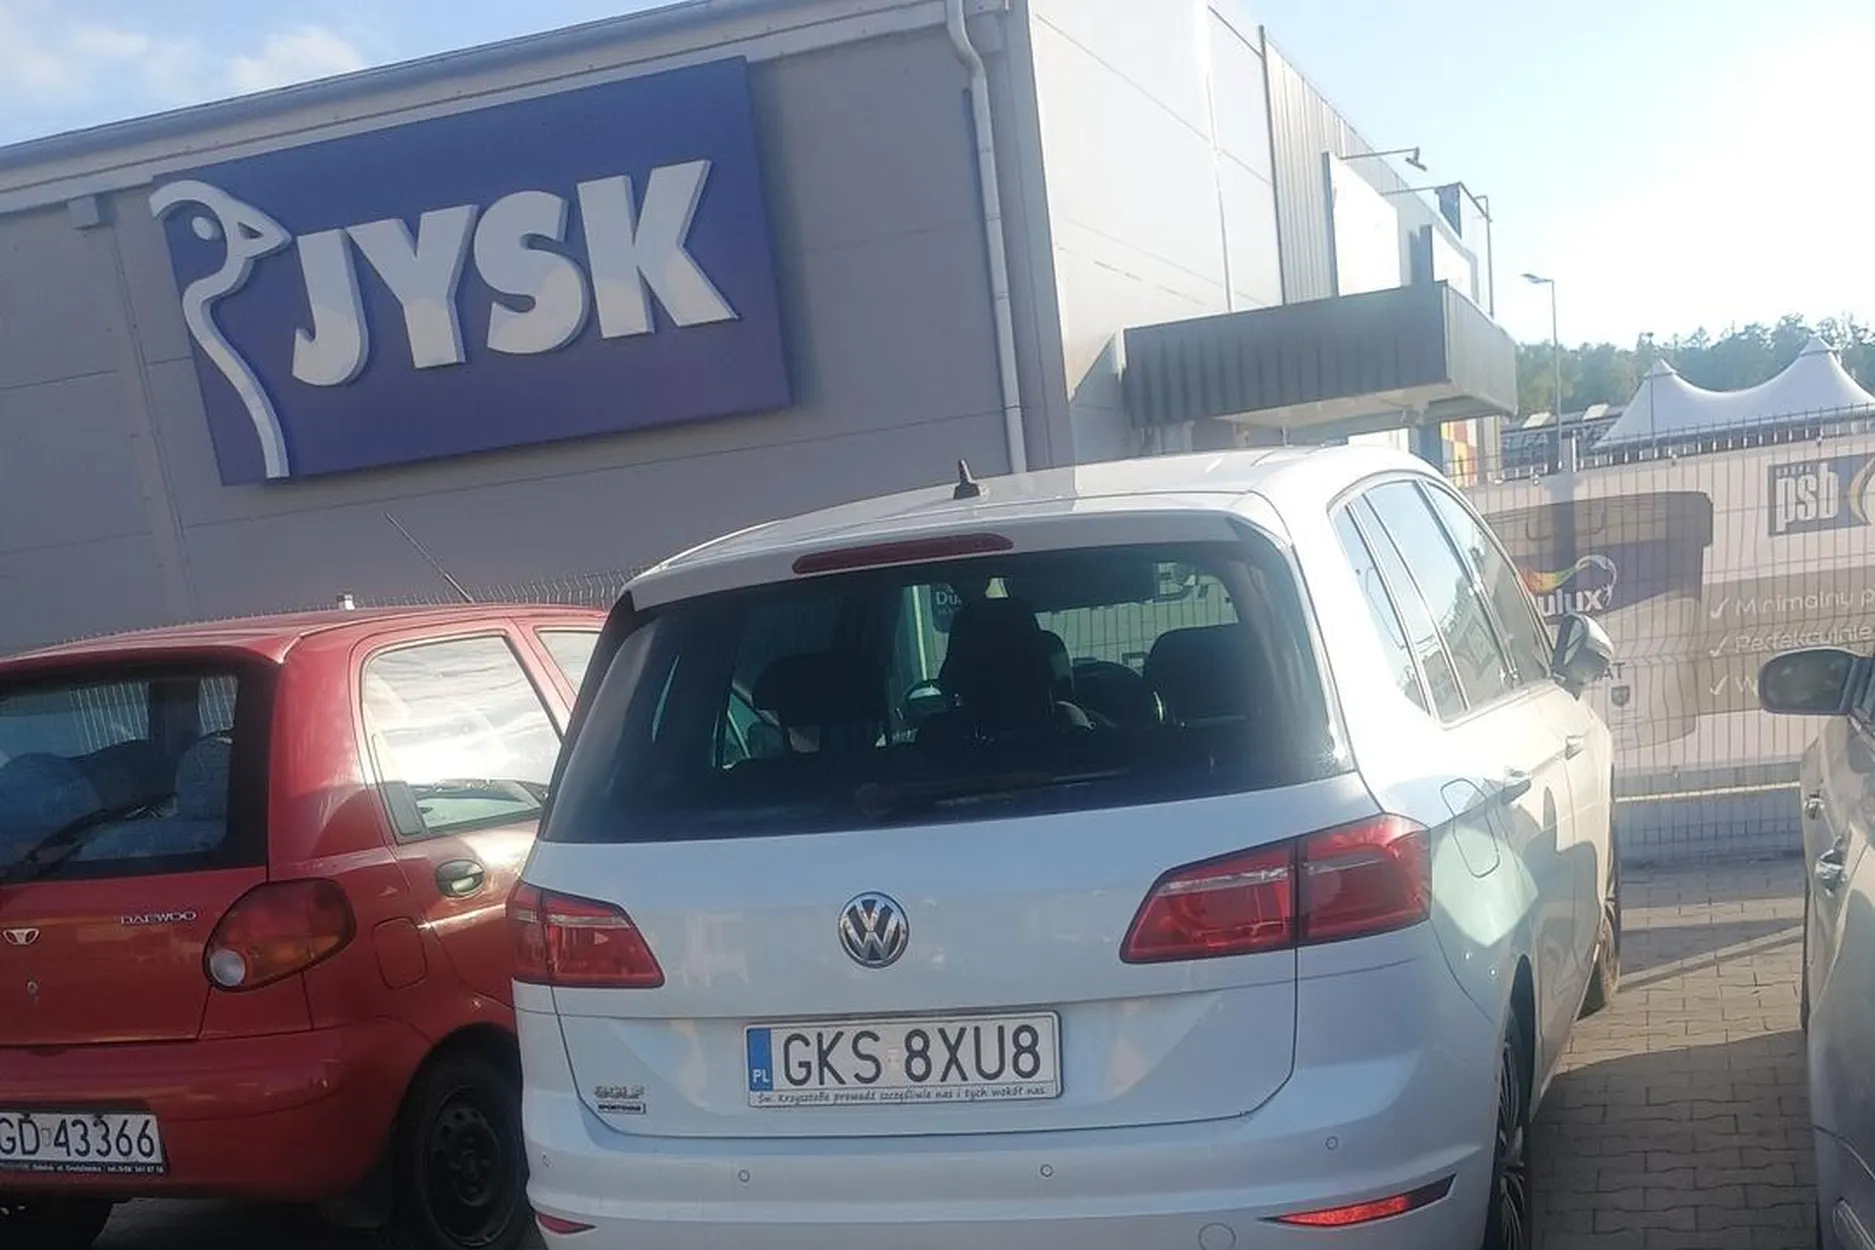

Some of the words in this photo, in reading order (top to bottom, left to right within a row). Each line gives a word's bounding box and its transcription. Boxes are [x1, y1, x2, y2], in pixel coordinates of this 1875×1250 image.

[292, 159, 741, 387] JYSK
[1775, 462, 1839, 532] psb
[1537, 588, 1603, 617] ulux
[1735, 591, 1853, 617] Mnimalny
[120, 910, 198, 925] DAEWOO
[783, 1030, 882, 1086] GKS
[904, 1023, 1041, 1083] 8XU8
[752, 1069, 771, 1084] PL
[0, 1116, 41, 1156] GD
[53, 1117, 156, 1158] 43366
